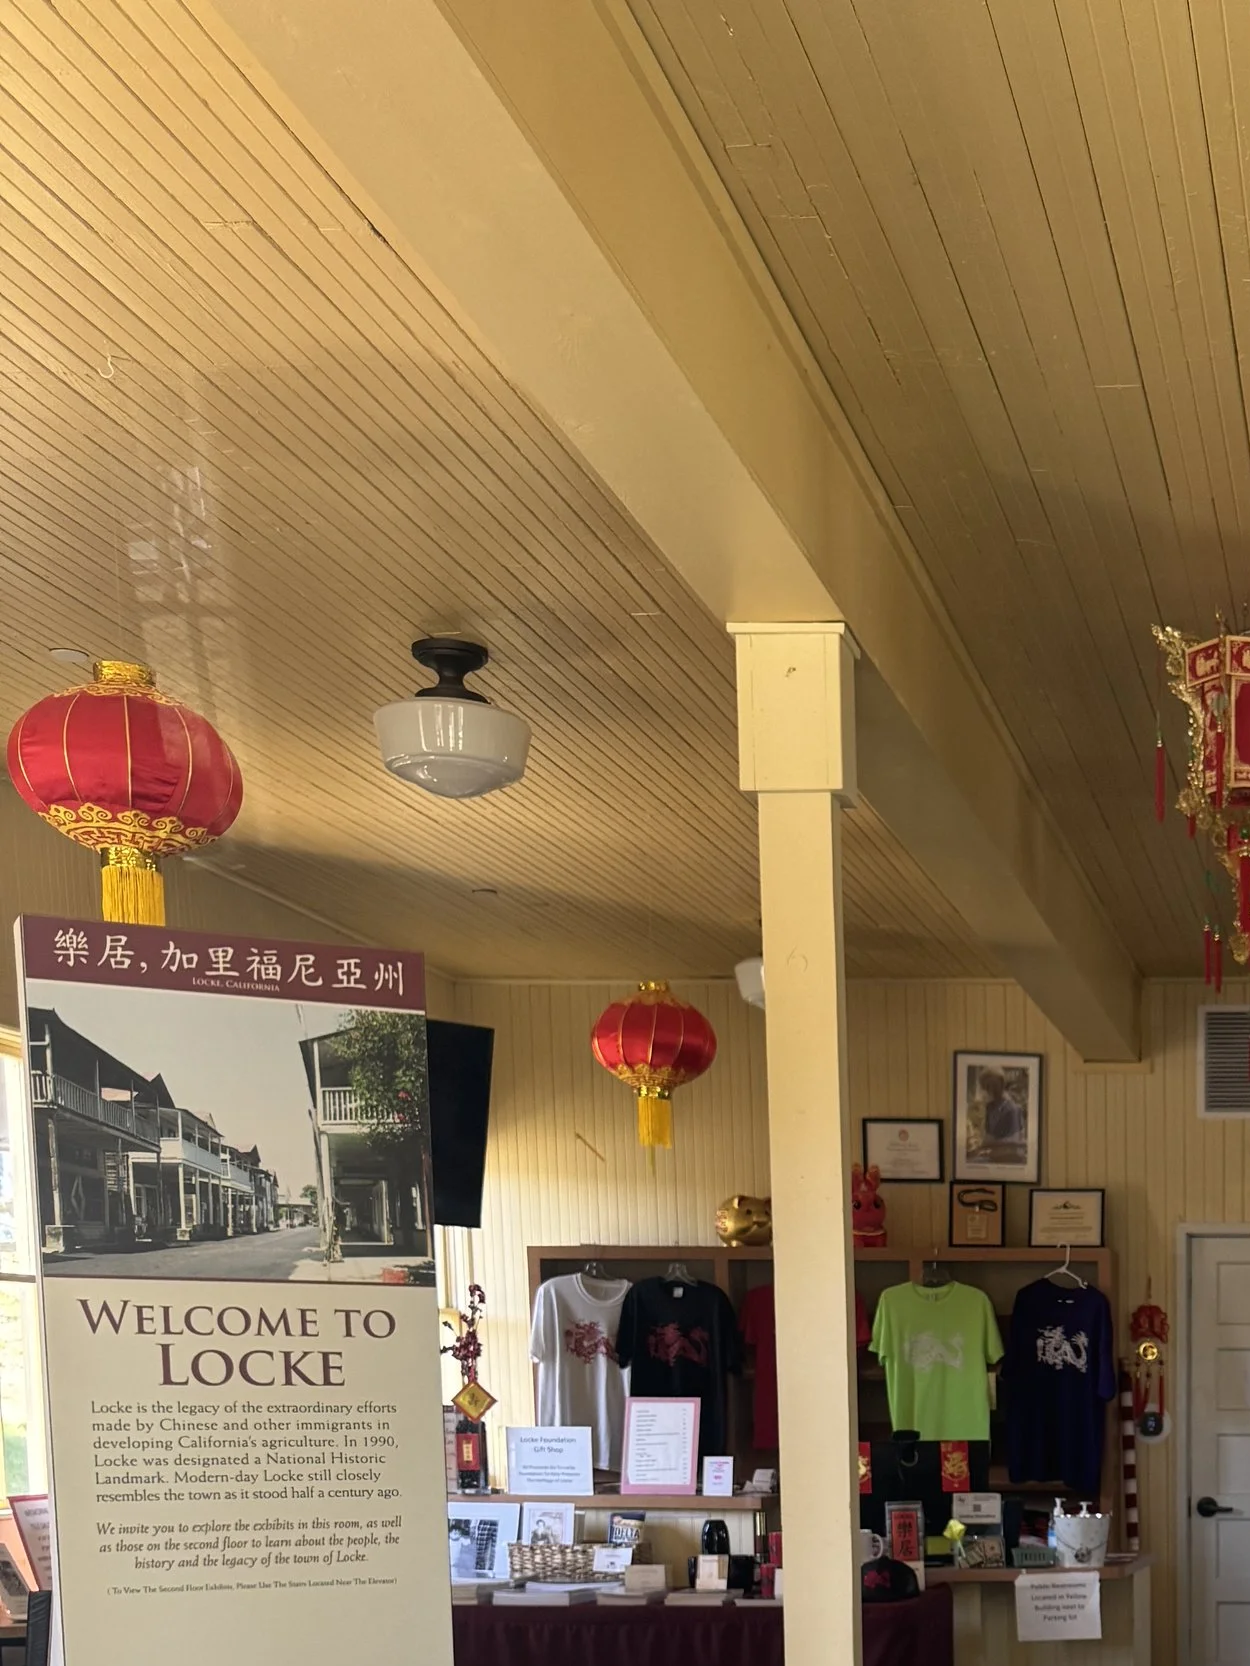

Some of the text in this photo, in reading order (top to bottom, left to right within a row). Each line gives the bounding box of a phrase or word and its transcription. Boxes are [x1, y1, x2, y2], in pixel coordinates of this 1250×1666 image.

[225, 979, 280, 993] CALIFORNIA
[77, 1298, 397, 1339] WELCOME TO
[158, 1343, 346, 1387] LOCKE
[91, 1400, 397, 1416] Locke is the legacy of the extraordinary efforts
[92, 1418, 390, 1433] made by Chinese and other immigrants in
[93, 1435, 399, 1451] developing California's agriculture. In 1990,
[94, 1452, 387, 1468] Locke was designated a National Historic
[95, 1468, 381, 1485] Landmark. Modern-day Locke still closely
[96, 1486, 402, 1503] resembles the town as it stood half a century ago.
[96, 1515, 402, 1537] We invite you to explore the exhibits in this room, as well
[613, 1527, 640, 1541] DELTA
[99, 1532, 400, 1553] as those on the second floor to learn about the people, the
[134, 1549, 369, 1571] history and the legacy of the town of Locke.
[123, 1586, 141, 1594] View
[142, 1585, 157, 1594] The
[158, 1584, 185, 1593] Second
[258, 1581, 272, 1589] Use
[273, 1580, 287, 1588] The
[335, 1578, 352, 1586] Near
[353, 1577, 367, 1585] The
